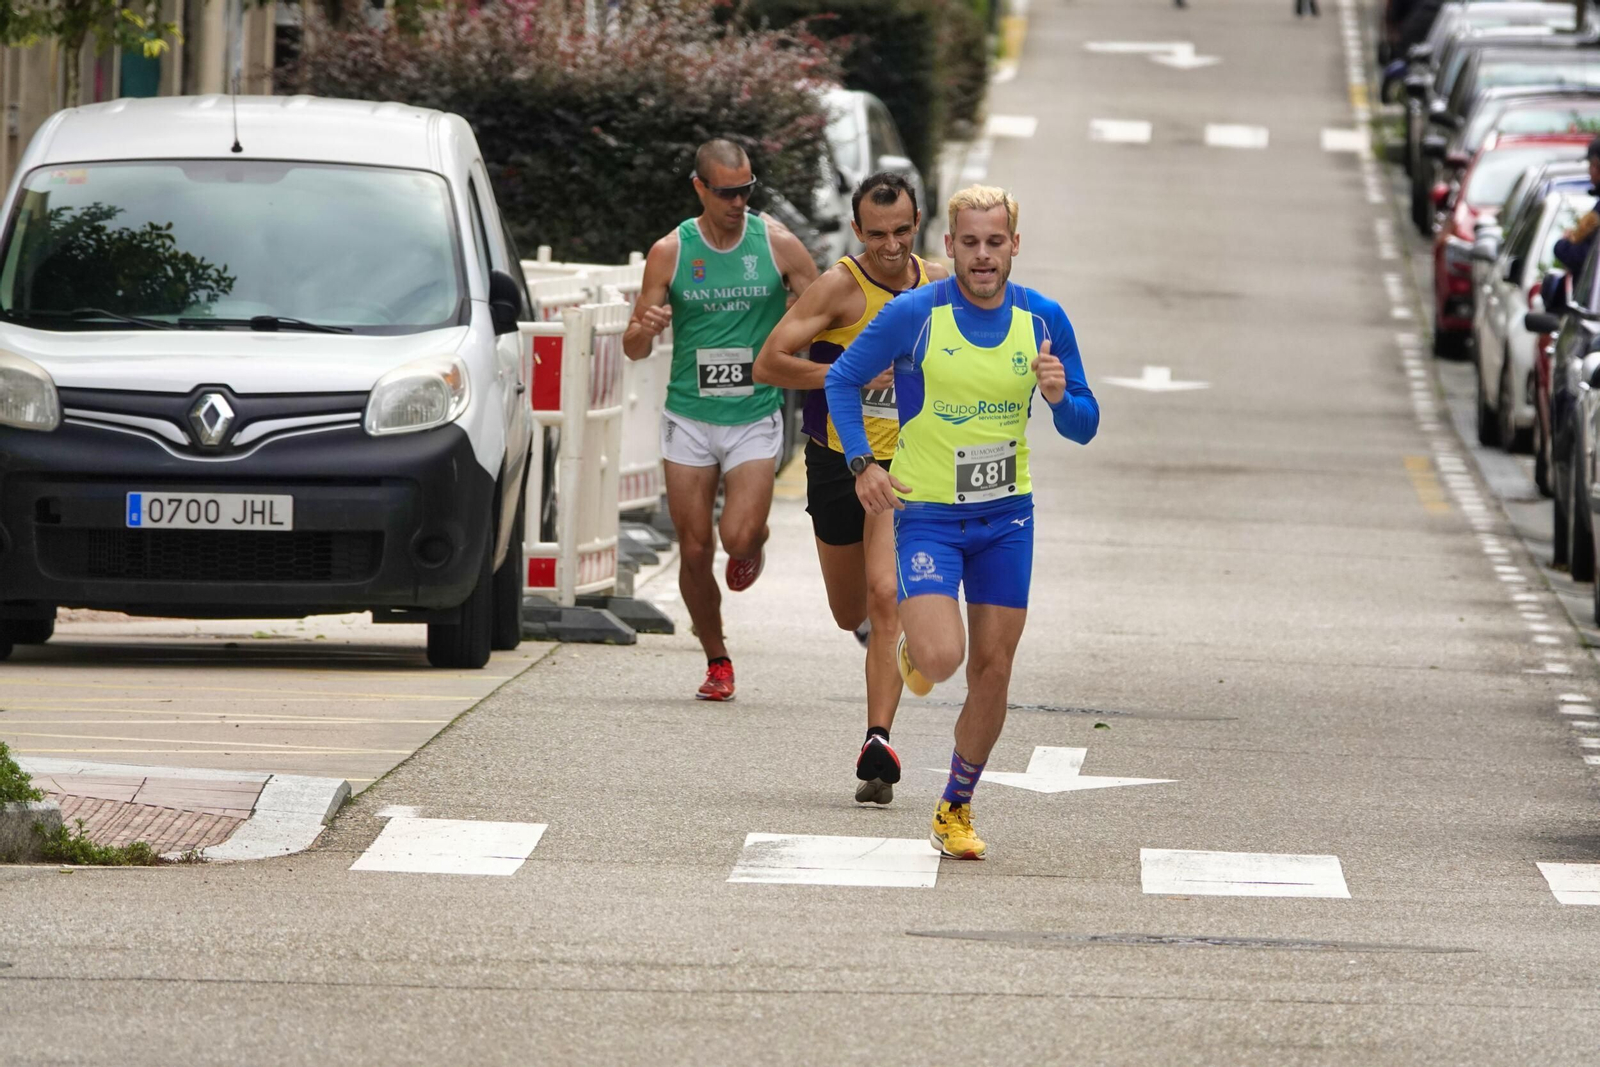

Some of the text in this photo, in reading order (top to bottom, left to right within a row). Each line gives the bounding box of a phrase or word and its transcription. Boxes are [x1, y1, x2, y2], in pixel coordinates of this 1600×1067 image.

[683, 286, 771, 301] SAN MIGUEL
[703, 299, 751, 312] MARÍN
[706, 364, 744, 384] 228
[970, 459, 1006, 487] 681
[148, 498, 284, 526] 0700 JHL
